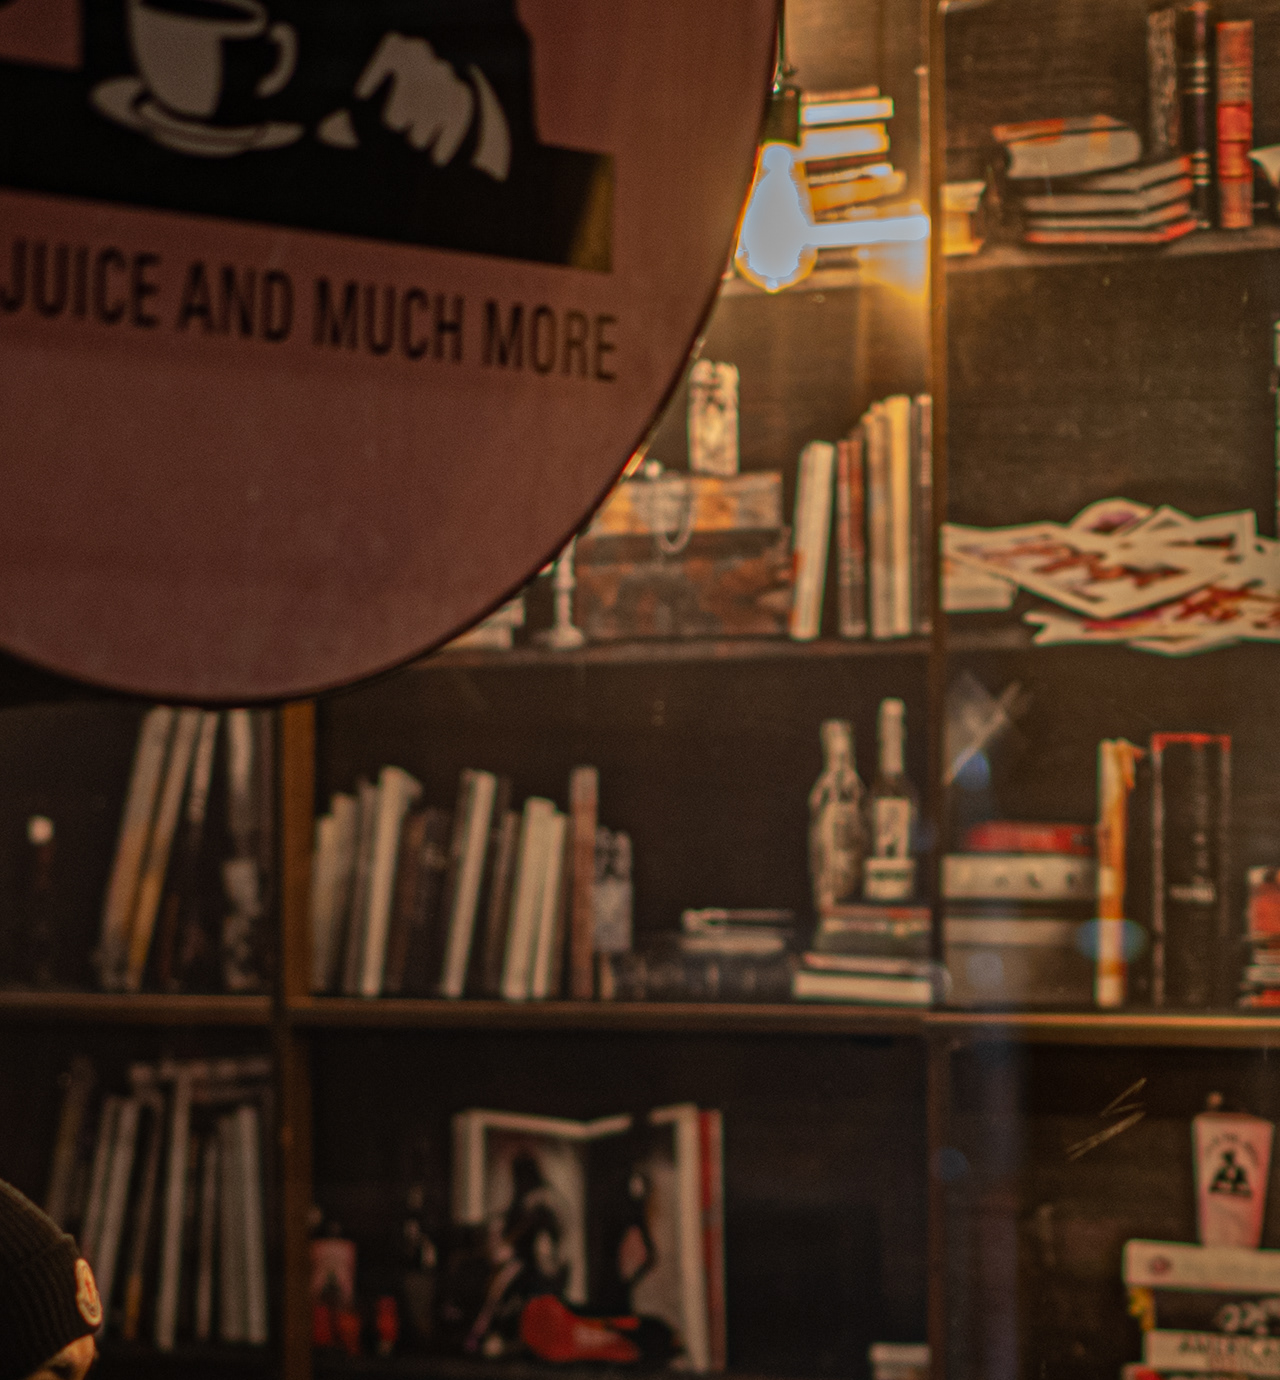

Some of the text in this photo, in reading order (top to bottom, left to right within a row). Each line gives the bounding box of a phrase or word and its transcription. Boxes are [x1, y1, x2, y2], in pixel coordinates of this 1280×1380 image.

[176, 260, 294, 343] AND
[314, 276, 467, 362] MUCH
[482, 300, 618, 383] MORE
